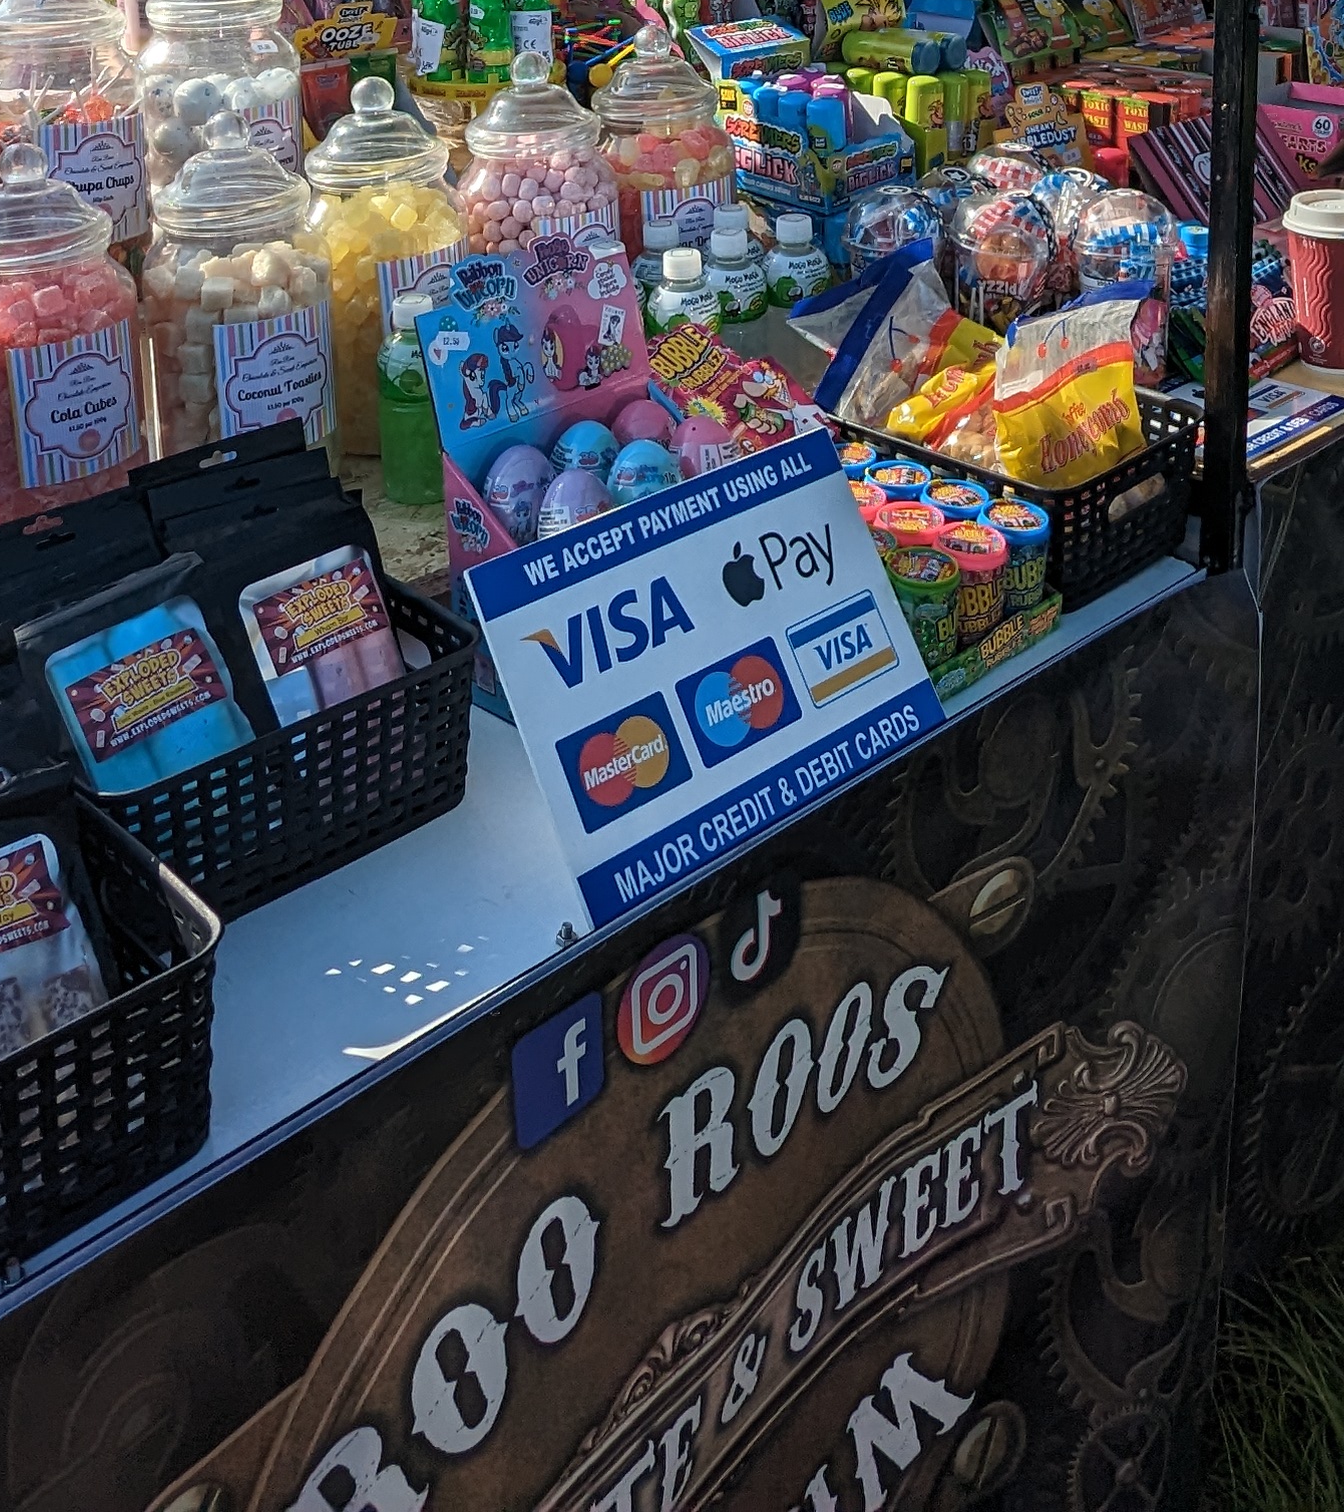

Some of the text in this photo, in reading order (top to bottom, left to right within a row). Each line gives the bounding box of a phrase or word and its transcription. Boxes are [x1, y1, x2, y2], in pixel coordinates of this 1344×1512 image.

[321, 23, 373, 43] OOZE
[732, 52, 803, 78] SCREAMERS
[725, 116, 803, 153] SCREAMERS
[1025, 122, 1056, 134] SNEAKY
[1315, 120, 1331, 130] 60
[106, 175, 135, 190] Chups
[458, 262, 503, 287] Ribbon
[524, 253, 590, 286] UNICORN
[650, 326, 709, 380] BUBBLE
[238, 371, 322, 402] Coconut Toasties
[1259, 392, 1288, 408] VISA
[50, 395, 117, 424] Cola Cubes
[1038, 388, 1131, 476] Honeycomb
[523, 452, 813, 587] WE ACCEPT PAYMENT USING ALL
[758, 523, 836, 591] Pay
[285, 581, 350, 619] EXPLODED
[303, 595, 350, 626] SWEETS
[521, 576, 696, 688] VISA
[814, 623, 874, 672] VISA
[980, 613, 1025, 658] BUBBLE
[102, 651, 180, 701] EXPLODED
[122, 669, 179, 707] SWEETS
[109, 691, 212, 748] WWW.EXPLODEDSWEETS.COM
[705, 678, 776, 729] Maestro
[583, 732, 668, 791] MasterCard
[613, 704, 921, 904] MAJOR CREDIT & DEBIT CARDS
[657, 964, 951, 1230] ROOS
[722, 1078, 1038, 1427] & SWEET
